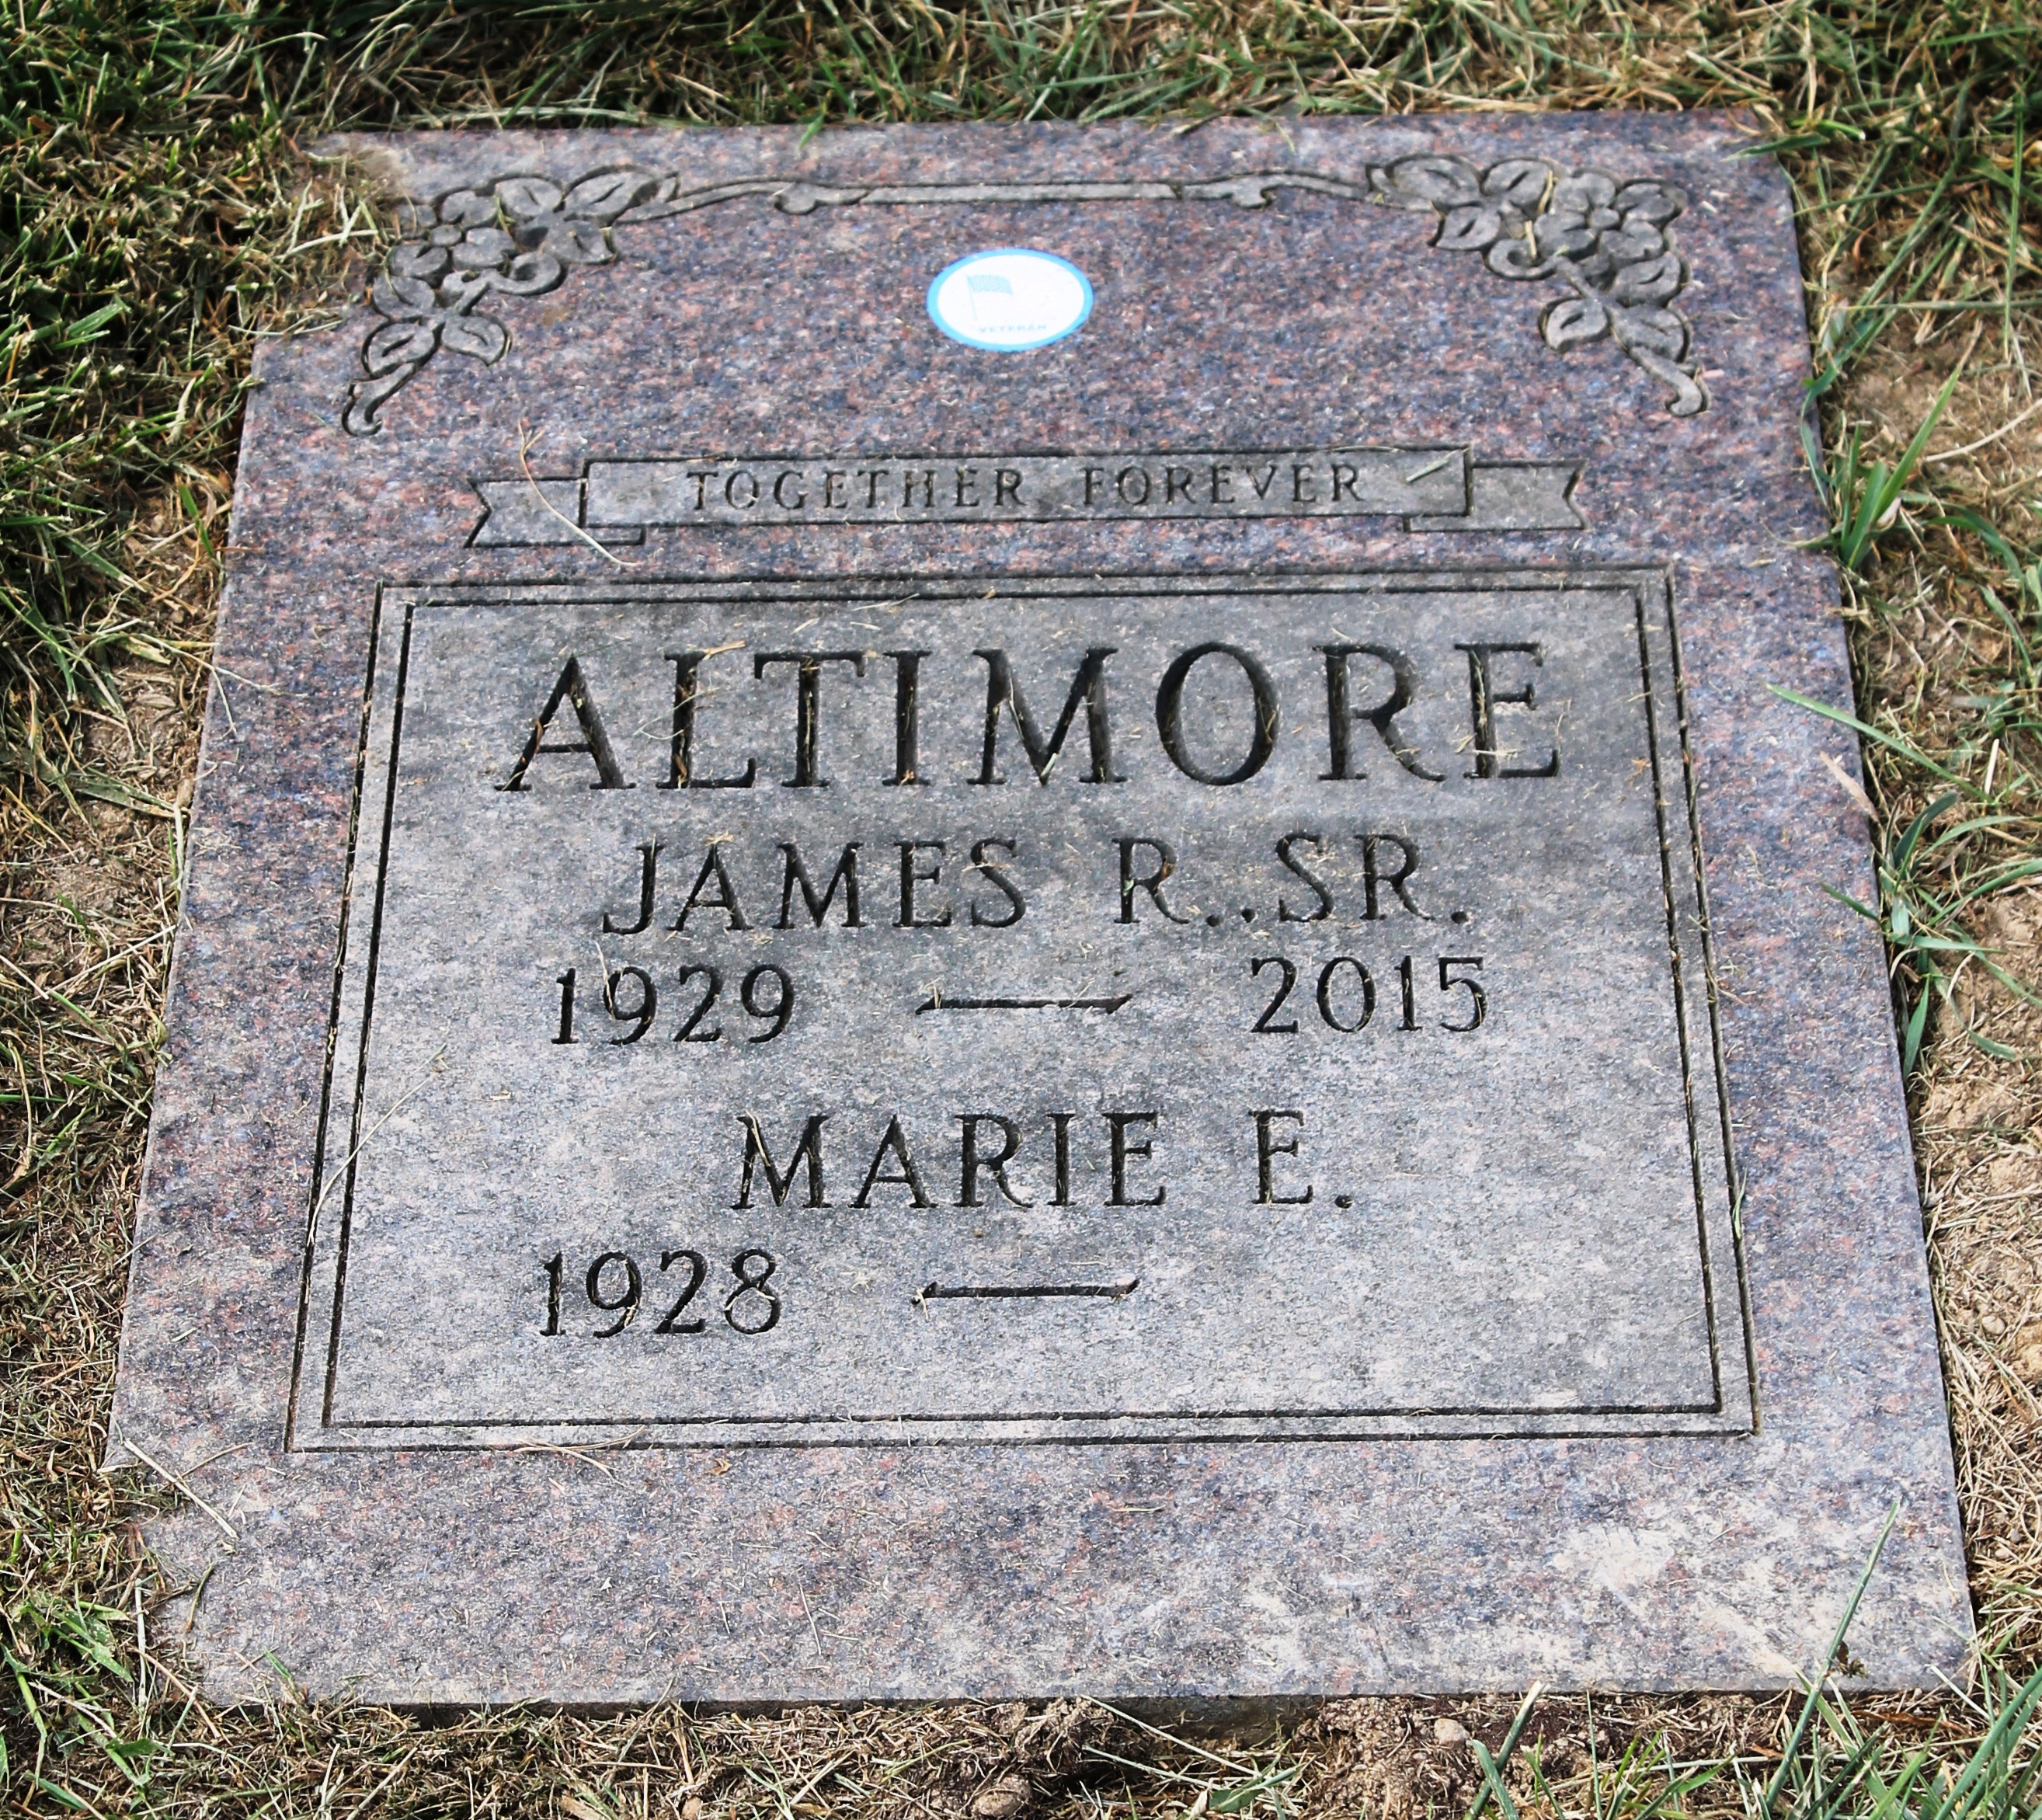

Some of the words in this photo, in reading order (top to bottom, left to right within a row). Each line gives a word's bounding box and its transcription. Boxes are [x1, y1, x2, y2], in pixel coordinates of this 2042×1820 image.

[979, 324, 1047, 333] VETERAN
[686, 468, 1027, 511] TOGETHER
[1083, 464, 1365, 506] FOREVER
[494, 642, 1561, 791] ALTIMORE
[602, 837, 1028, 934] JAMES
[551, 964, 795, 1046] 1929
[1250, 956, 1487, 1034] 2015
[732, 1112, 1167, 1209] MARIE
[1251, 1109, 1355, 1209] E.
[537, 1249, 782, 1337] 1928
